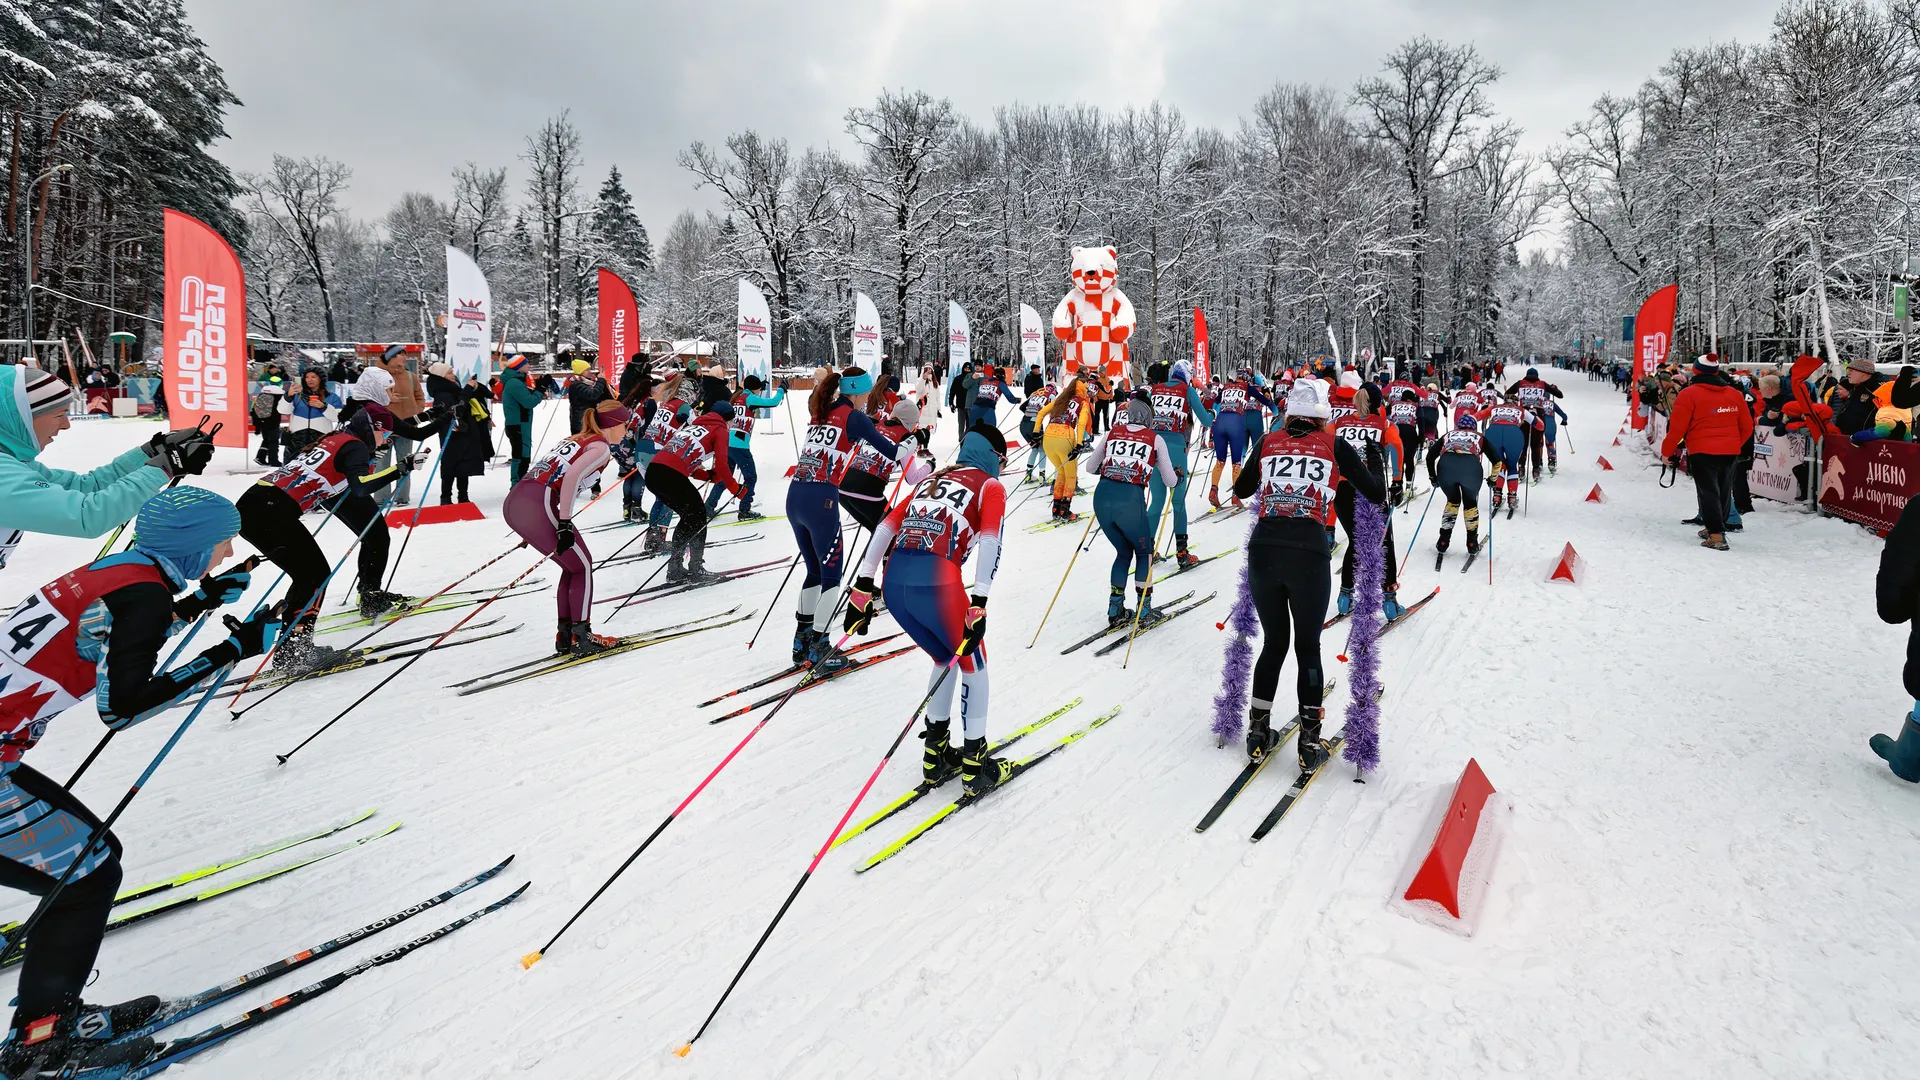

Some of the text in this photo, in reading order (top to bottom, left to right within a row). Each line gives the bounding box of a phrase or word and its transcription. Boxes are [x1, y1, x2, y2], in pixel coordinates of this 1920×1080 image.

[1522, 388, 1543, 396] 1241
[1152, 396, 1182, 410] 1244
[807, 427, 837, 446] 1259
[1340, 428, 1378, 441] 1301
[1109, 441, 1148, 460] 1314
[1267, 456, 1325, 482] 1213
[1866, 461, 1906, 488] ДИВНО
[335, 899, 433, 945] salomon
[342, 926, 445, 977] salomon
